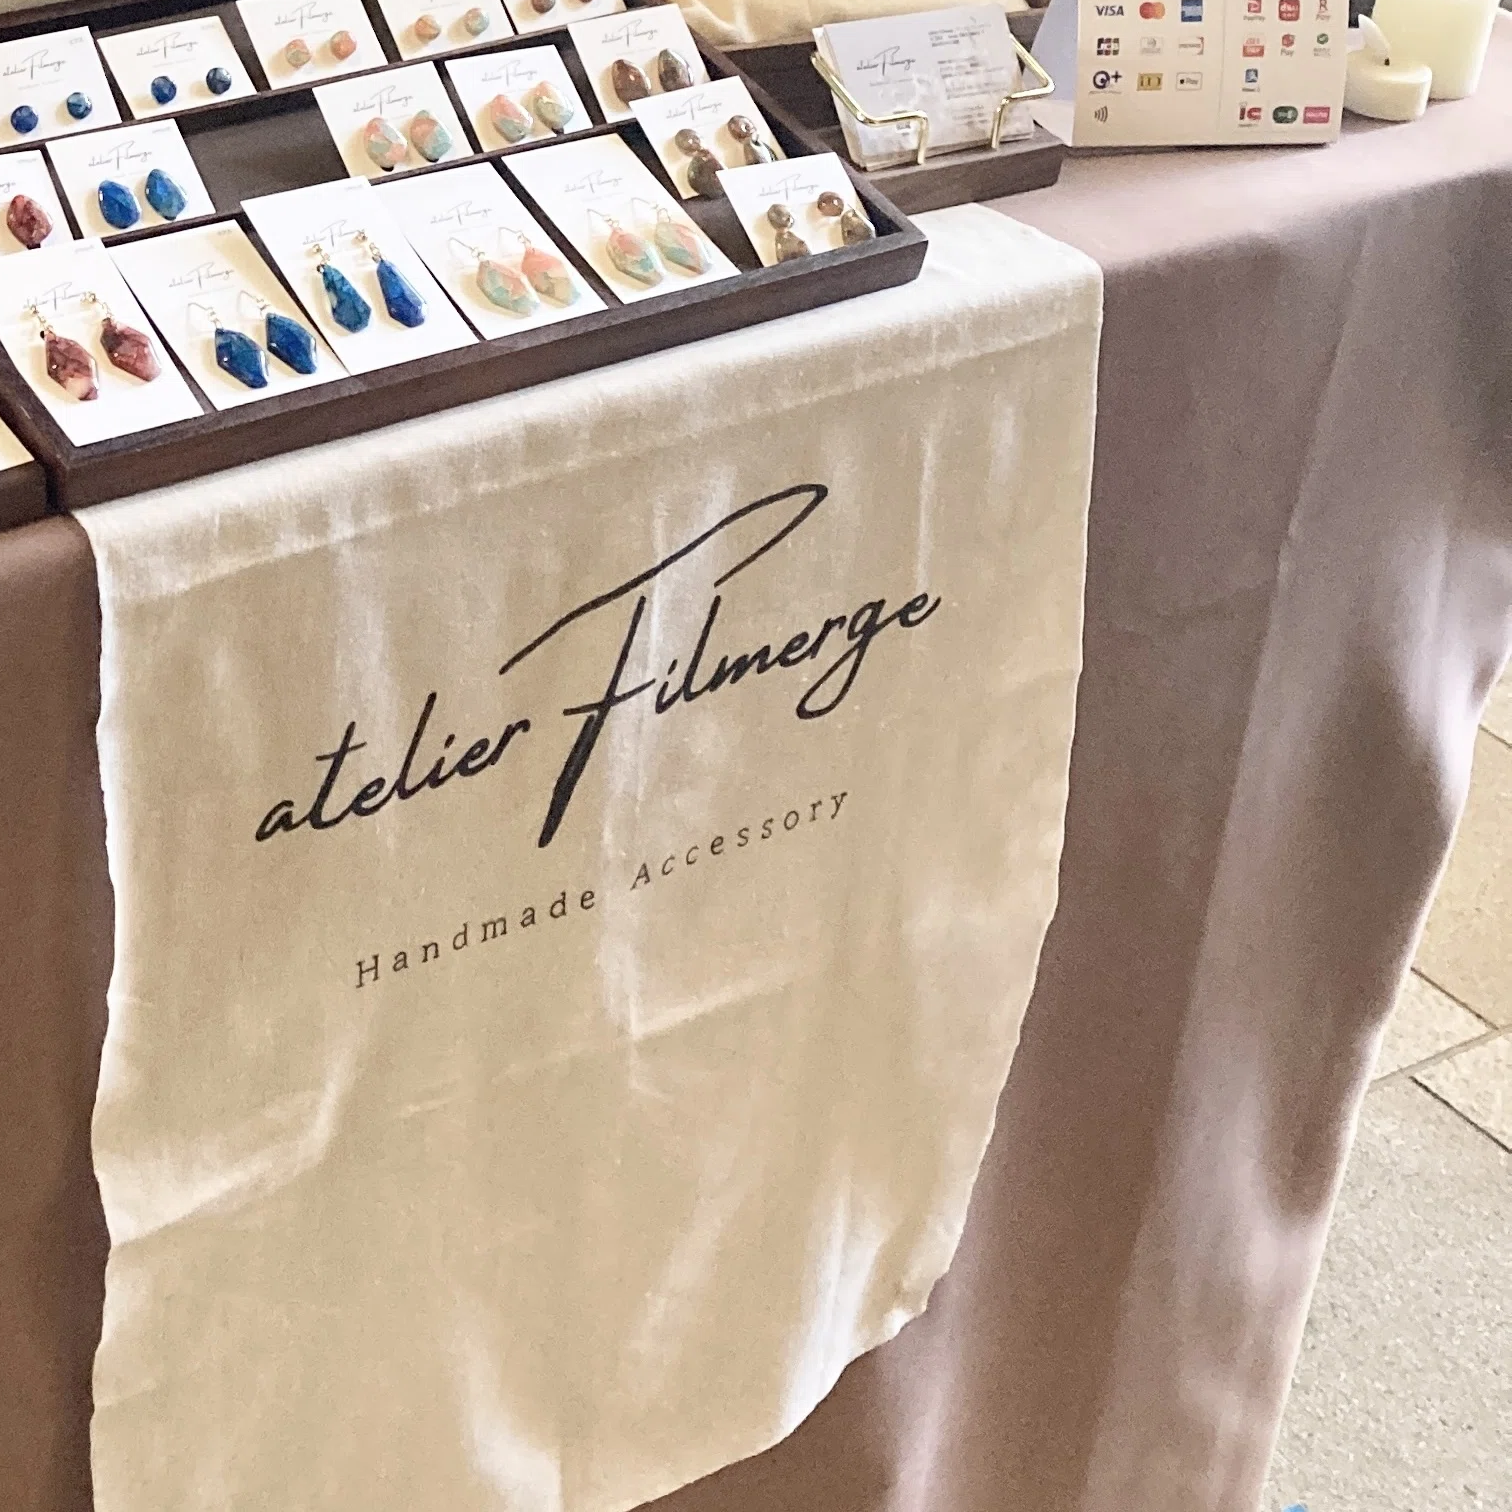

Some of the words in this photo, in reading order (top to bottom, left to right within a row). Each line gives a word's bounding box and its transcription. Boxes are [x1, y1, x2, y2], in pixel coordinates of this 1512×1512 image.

[1095, 5, 1126, 16] VISA
[255, 690, 531, 843] atelier
[499, 482, 943, 849] Filmerge
[353, 888, 598, 989] Handmade
[629, 787, 849, 891] Accessory
